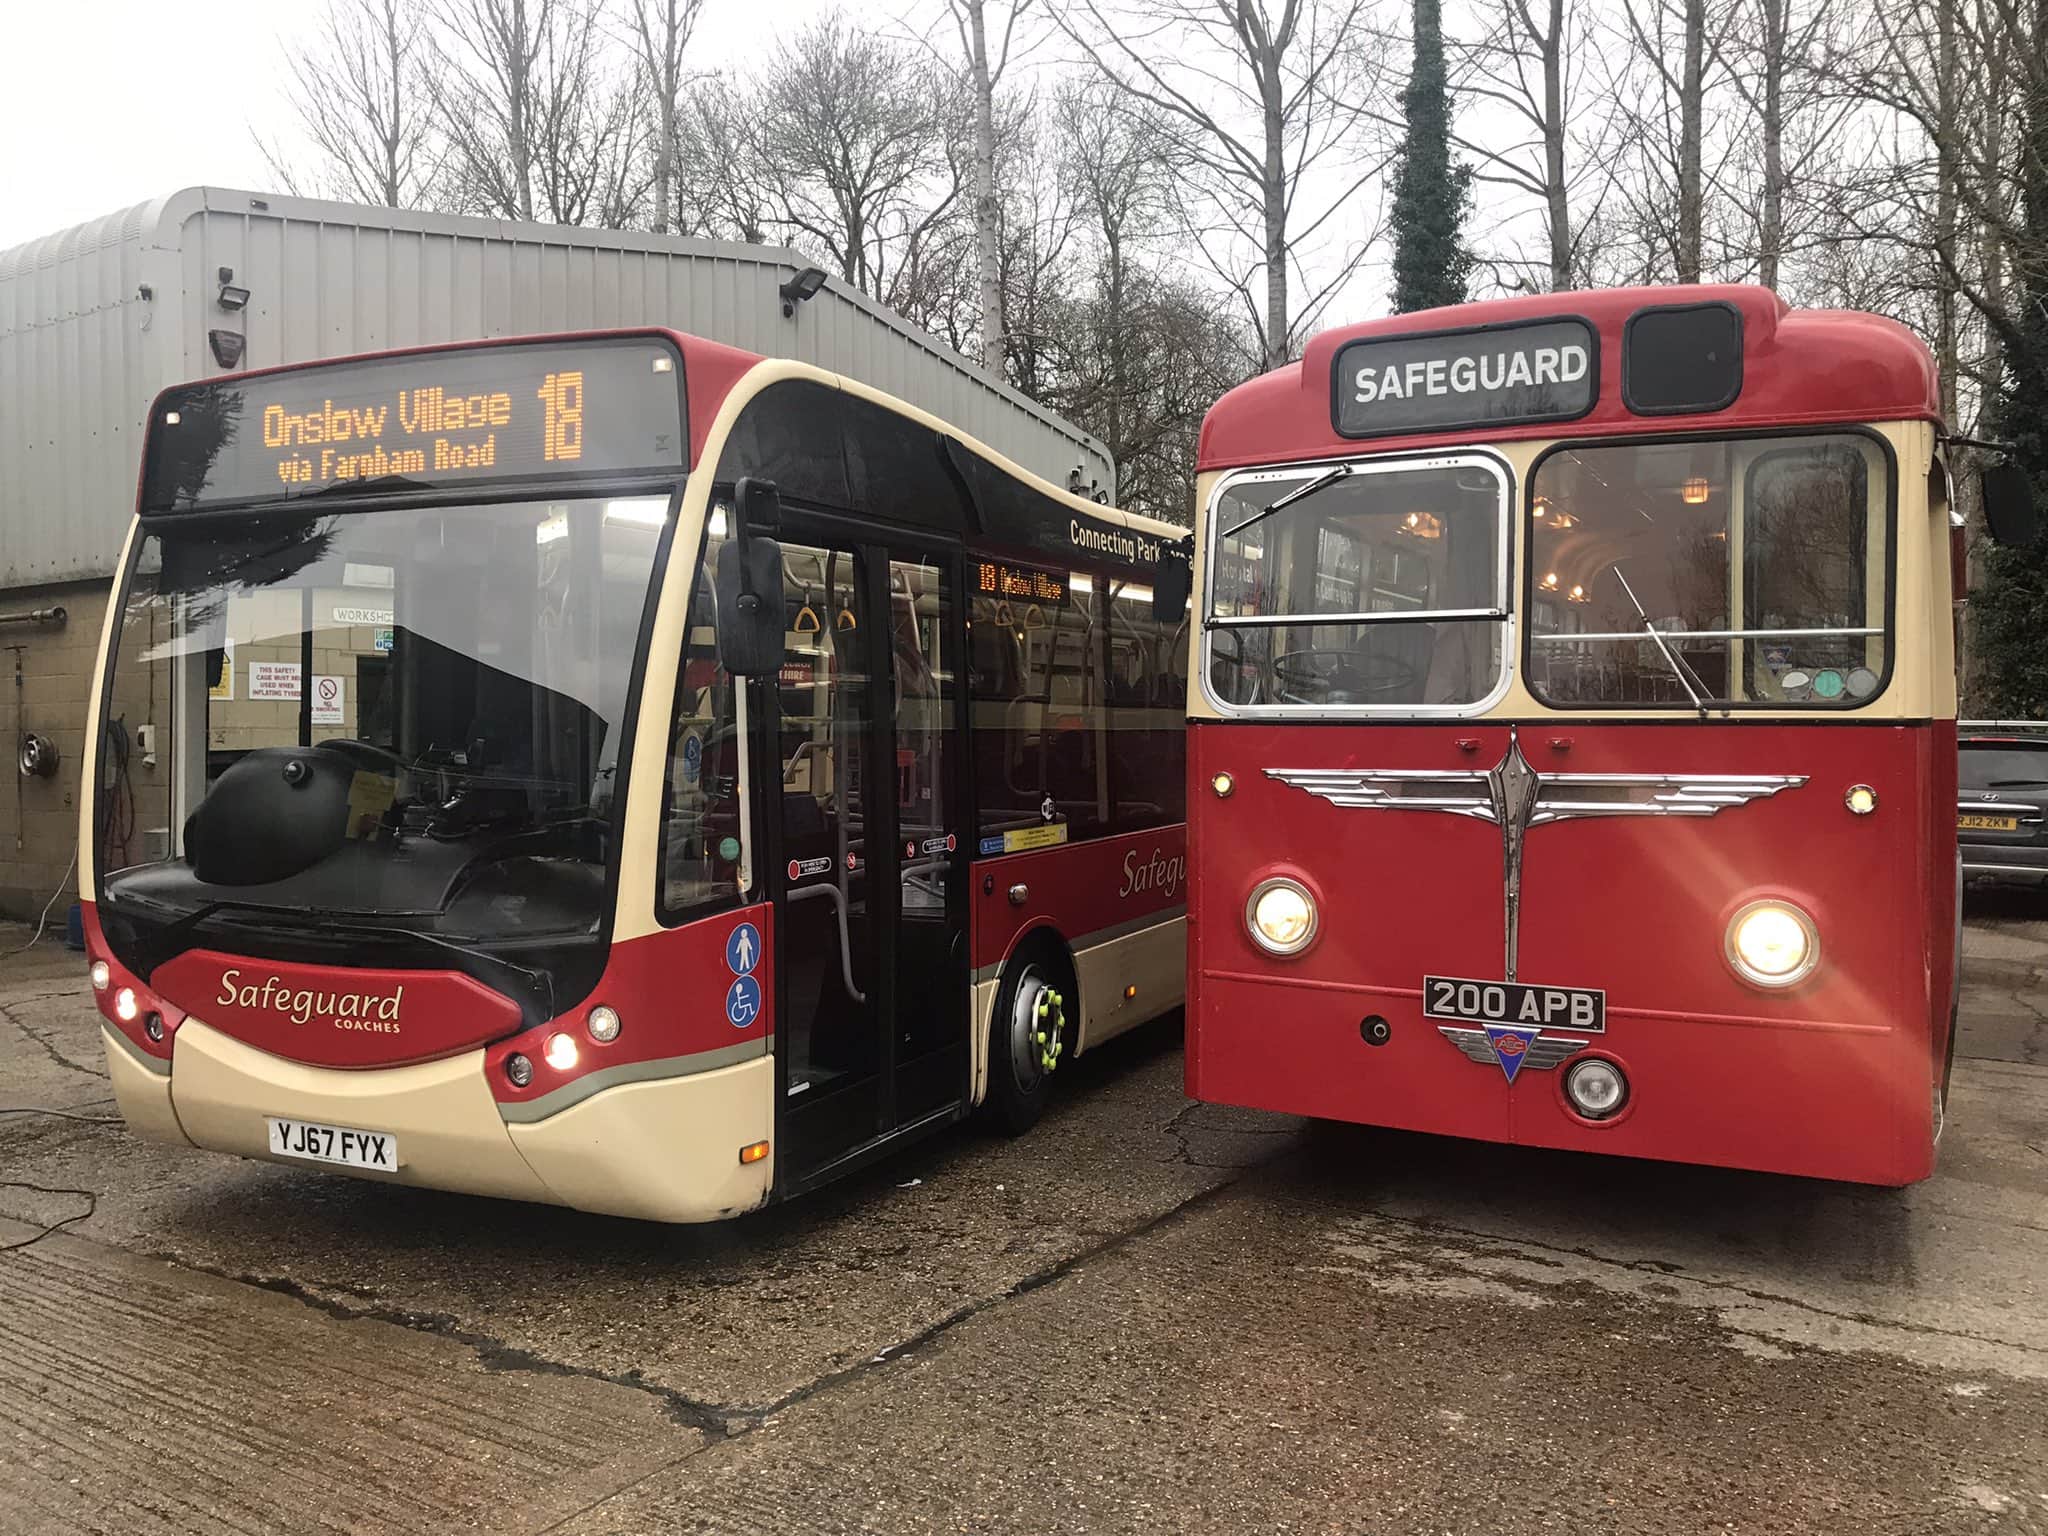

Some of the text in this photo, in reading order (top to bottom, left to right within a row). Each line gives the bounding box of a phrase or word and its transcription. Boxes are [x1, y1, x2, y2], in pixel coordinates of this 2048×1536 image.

[1354, 345, 1588, 404] SAFEGUARD
[263, 386, 512, 448] Onslow Village
[537, 371, 584, 462] 18
[278, 433, 495, 483] via Farnham Road
[1069, 519, 1135, 564] Connecting
[1137, 536, 1161, 563] Park
[980, 563, 996, 591] 18
[216, 969, 405, 1025] Safeguard
[1432, 981, 1595, 1026] 200 APB
[334, 1018, 401, 1034] COACHES
[278, 1122, 387, 1165] YJ67 FYX
